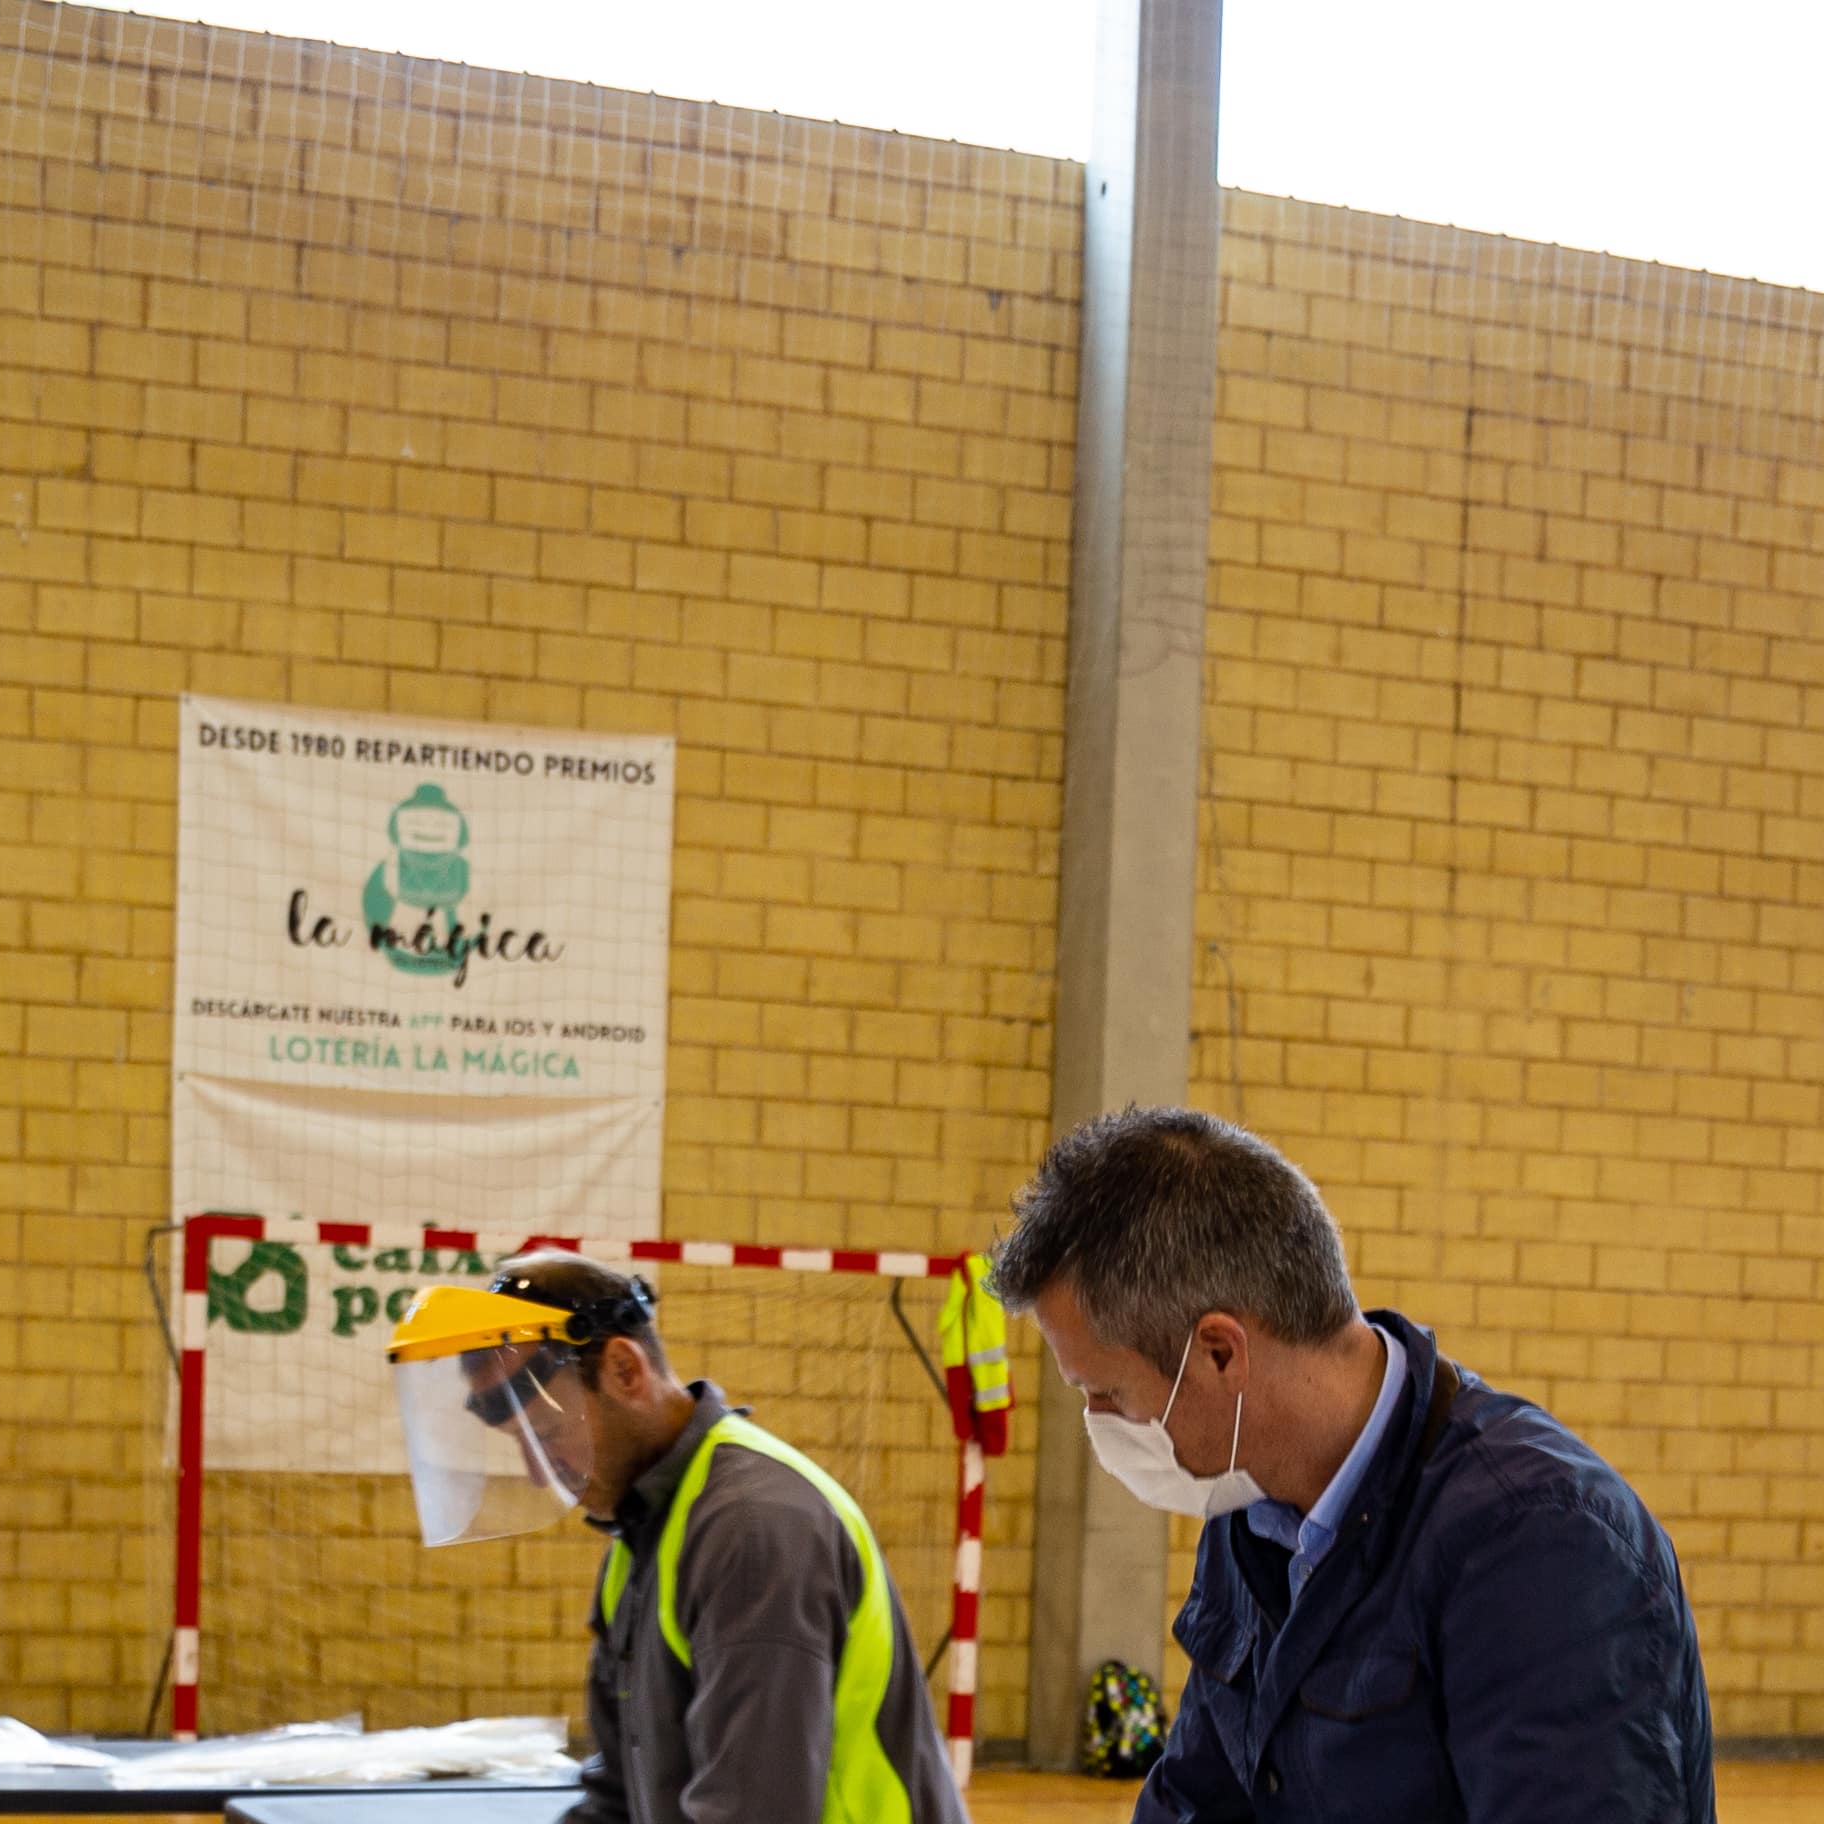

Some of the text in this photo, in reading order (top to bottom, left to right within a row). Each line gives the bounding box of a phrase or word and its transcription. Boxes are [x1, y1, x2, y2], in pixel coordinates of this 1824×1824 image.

[199, 723, 656, 785] DESDE 1980 REPARTIENDO PREMIOS
[288, 889, 564, 989] la mágica
[318, 1007, 401, 1028] NUESTRA
[451, 1015, 497, 1035] PARA
[542, 1022, 554, 1038] Y
[561, 1023, 646, 1043] ANDROID
[269, 1034, 580, 1078] LOTERÍA LA MÁGICA
